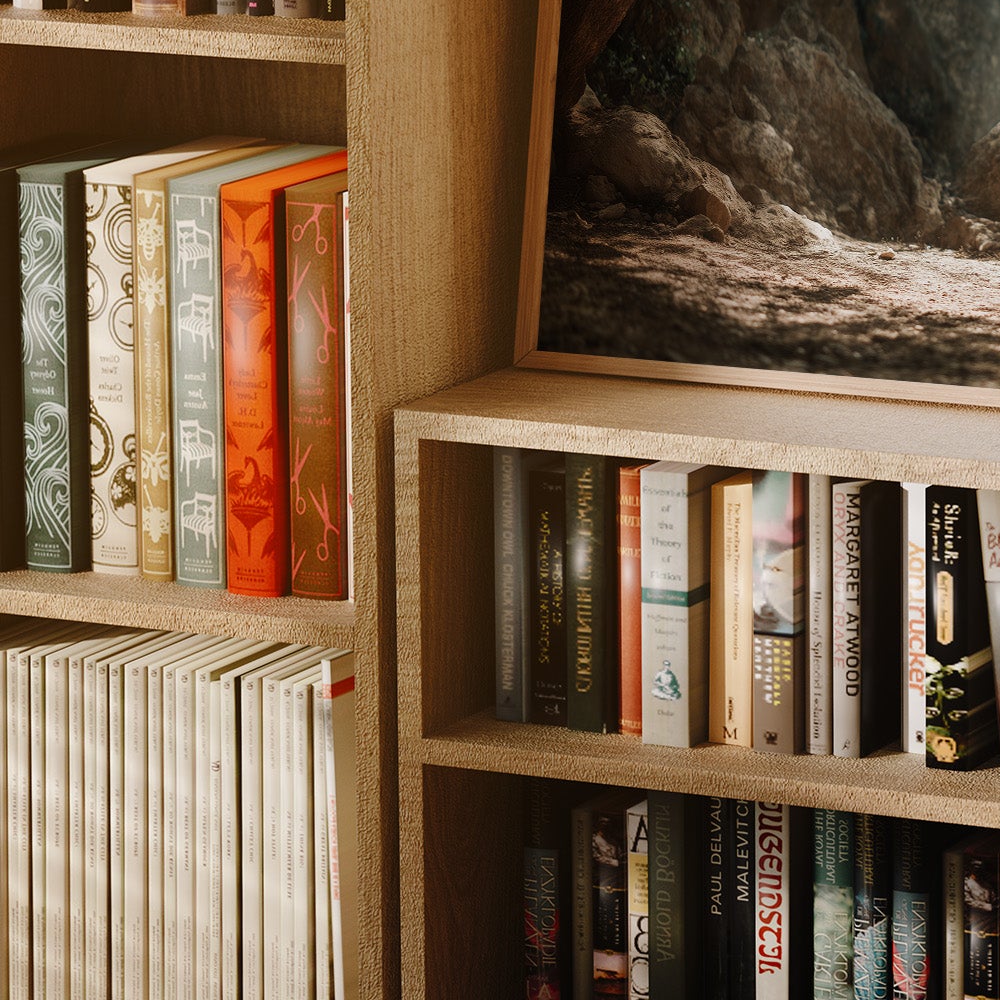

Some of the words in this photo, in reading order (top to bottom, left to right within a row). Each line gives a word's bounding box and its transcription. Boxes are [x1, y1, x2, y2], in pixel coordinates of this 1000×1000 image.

[501, 454, 514, 528] DOWNTOWN
[833, 491, 846, 545] ORYX
[501, 530, 514, 557] OWL
[833, 549, 846, 597] AND
[846, 493, 860, 606] MARGARET
[501, 563, 514, 605] CHUCK
[501, 609, 514, 690] KLOSTERMAN
[811, 640, 823, 689] Splendid
[833, 601, 846, 670] CRAKE
[846, 611, 860, 696] ATWOOD
[710, 797, 722, 865] DELVAU
[710, 871, 722, 916] PAUL
